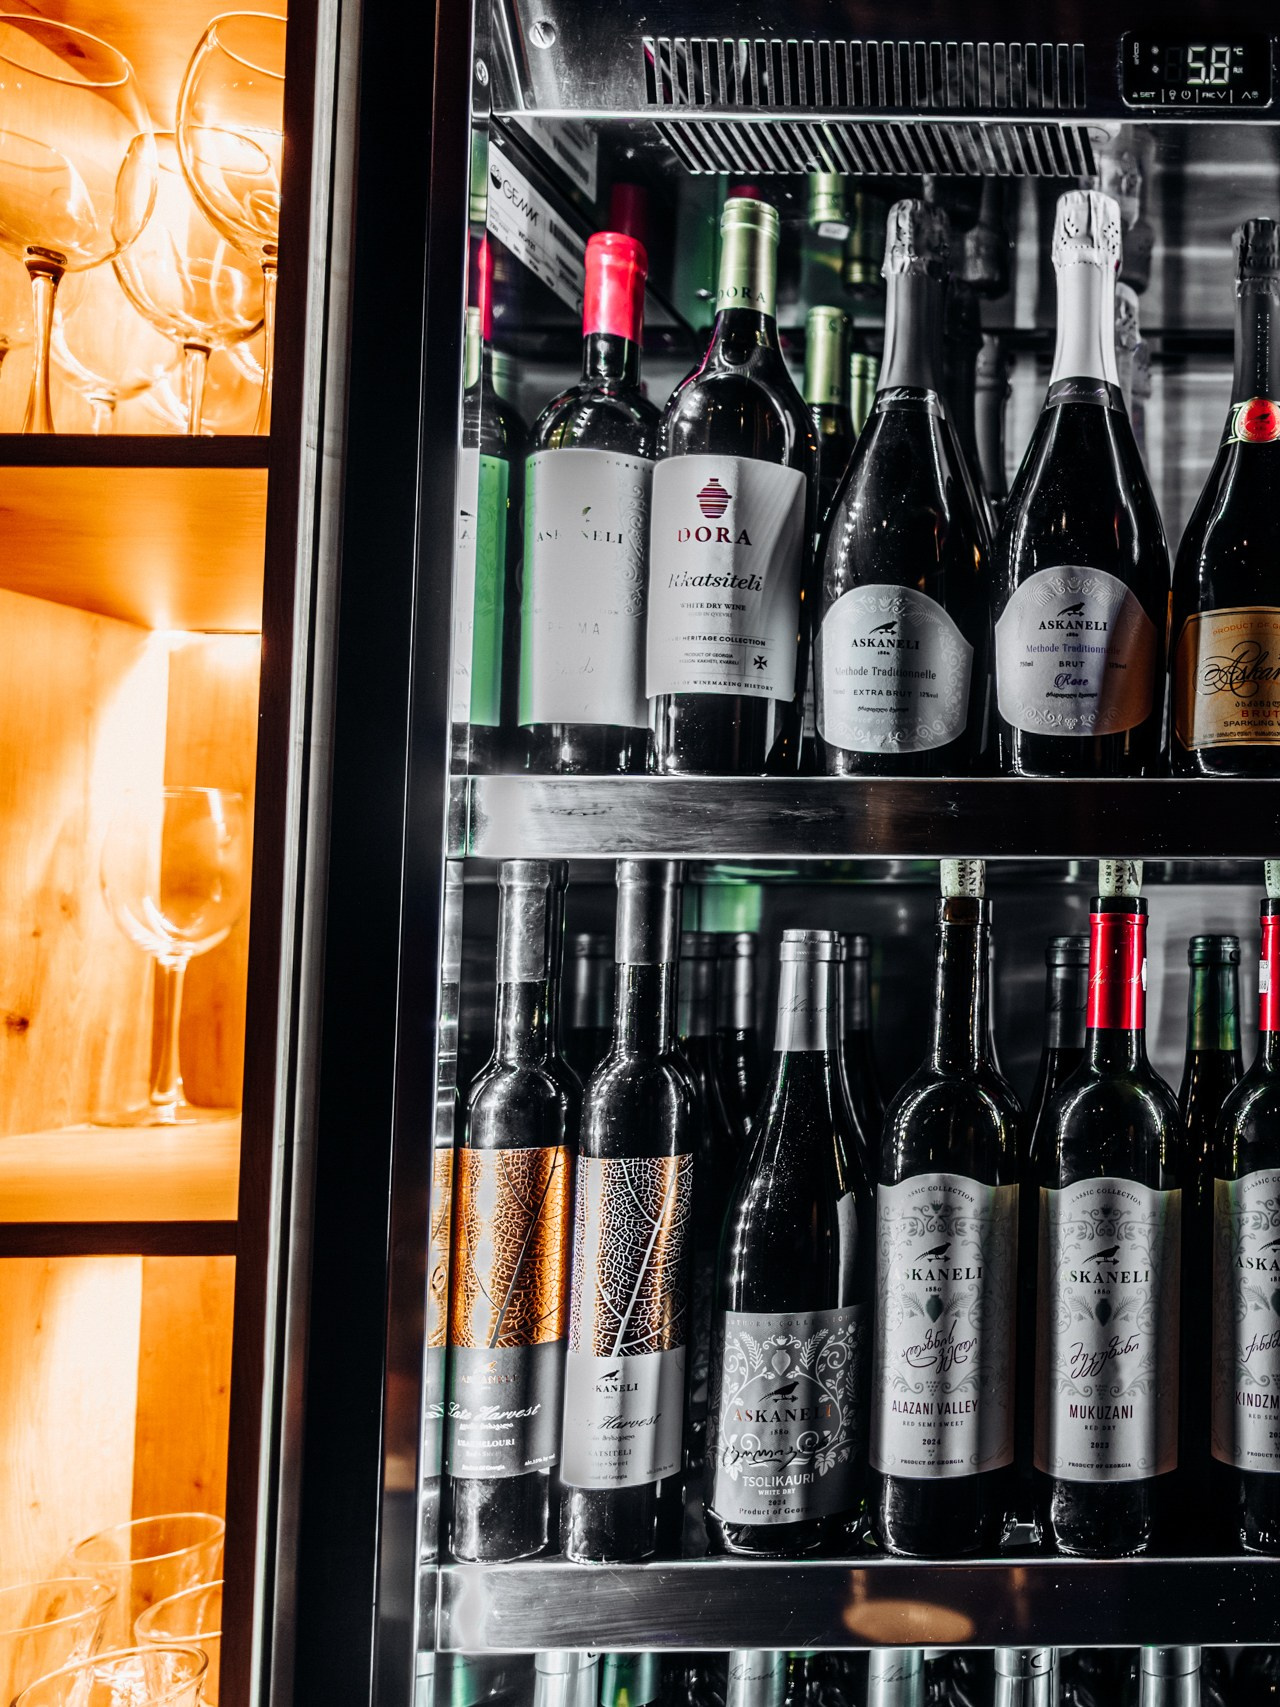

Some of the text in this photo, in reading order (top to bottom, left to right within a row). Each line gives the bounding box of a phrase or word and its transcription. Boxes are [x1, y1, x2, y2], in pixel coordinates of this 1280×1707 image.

[1187, 46, 1230, 84] 5.8
[677, 526, 753, 546] DORA
[724, 603, 747, 612] WINE
[1038, 620, 1108, 631] ASKANELI
[1212, 622, 1254, 637] PRODUCT
[719, 636, 766, 647] COLLECTION
[851, 638, 920, 650] ASKANELI
[1026, 644, 1060, 654] Methode
[871, 666, 937, 680] Traditionnelle
[744, 683, 774, 692] HISTORY
[1053, 673, 1089, 689] Rose
[853, 689, 884, 697] EXTRA
[885, 690, 913, 698] BRUT
[1241, 710, 1280, 718] BRUT
[1223, 720, 1274, 728] SPARKLING
[928, 1185, 975, 1203] COLLECTION
[1071, 1188, 1142, 1206] LASSIC COLLECTION
[904, 1267, 983, 1281] SKANELI
[1068, 1270, 1150, 1284] SKANELI
[594, 1383, 639, 1393] KANELI
[473, 1403, 541, 1420] Harvest
[733, 1404, 833, 1423] ASKANELI
[892, 1399, 979, 1415] ALAZANI VALLEY
[1069, 1404, 1133, 1420] MUKUZANI
[598, 1412, 662, 1430] Harvest
[939, 1420, 964, 1428] SWEET
[922, 1438, 941, 1446] 2024
[900, 1458, 926, 1466] PRODUCT
[742, 1472, 815, 1488] TSOLIKAURI
[739, 1508, 770, 1516] Product
